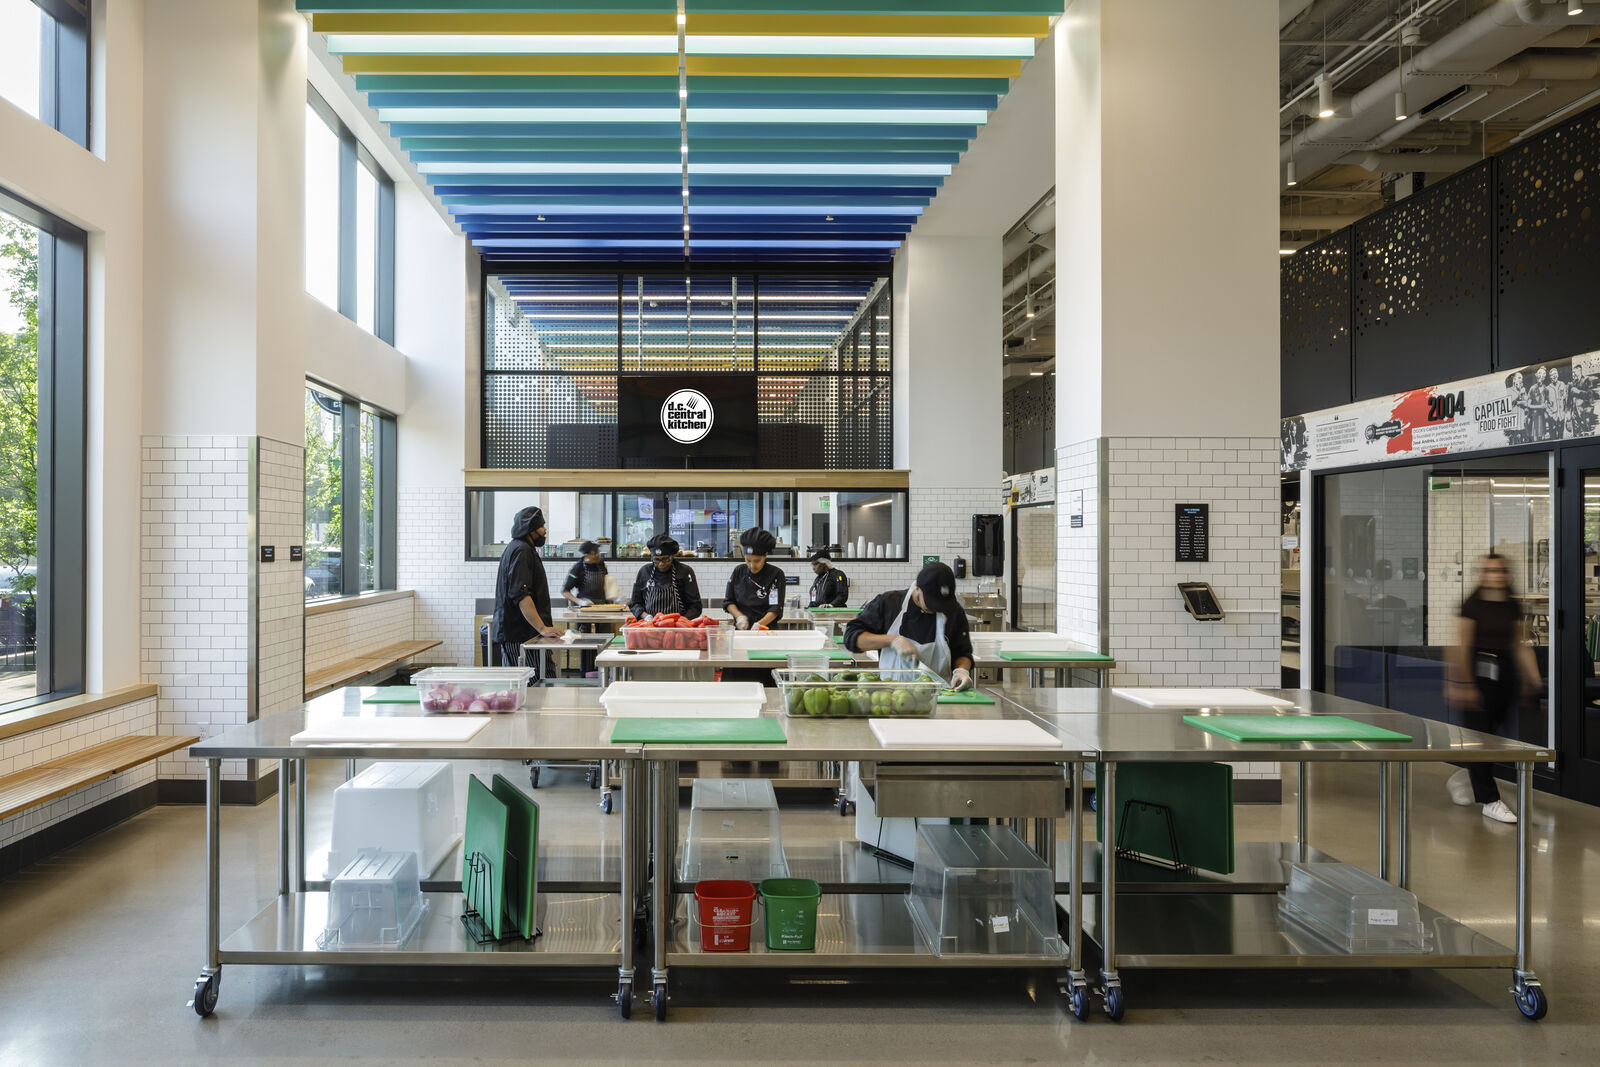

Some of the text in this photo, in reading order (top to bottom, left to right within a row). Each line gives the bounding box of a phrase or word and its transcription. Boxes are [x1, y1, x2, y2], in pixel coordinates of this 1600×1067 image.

[668, 401, 687, 410] d.c.
[1428, 390, 1465, 421] 2004
[1474, 398, 1512, 421] CAPITAL
[668, 410, 706, 419] central
[668, 420, 706, 429] kitchen
[1480, 416, 1516, 431] FOOD FIGHT
